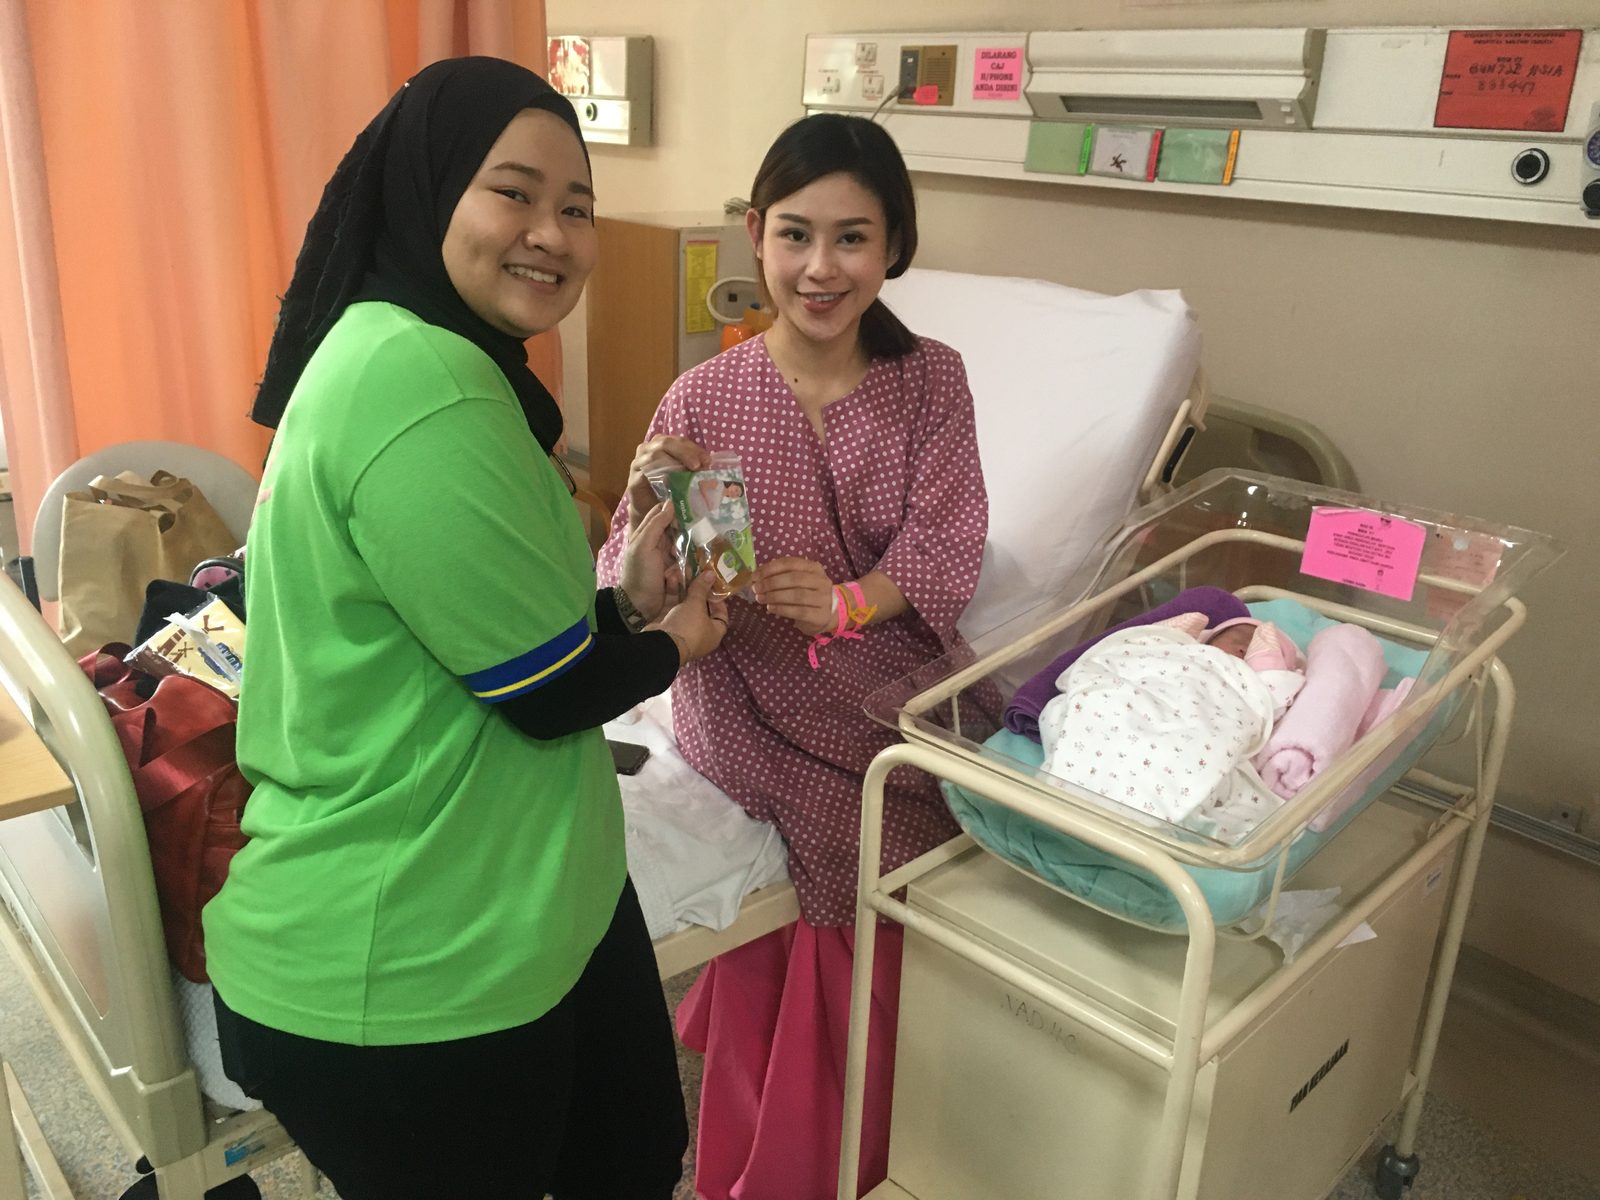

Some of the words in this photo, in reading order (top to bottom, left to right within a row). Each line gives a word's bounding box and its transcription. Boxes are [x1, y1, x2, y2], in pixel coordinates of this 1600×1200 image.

[981, 51, 1017, 59] DILARANG
[990, 62, 1006, 70] CAJ
[980, 73, 1014, 82] H/PHONE
[974, 83, 994, 91] ANDA
